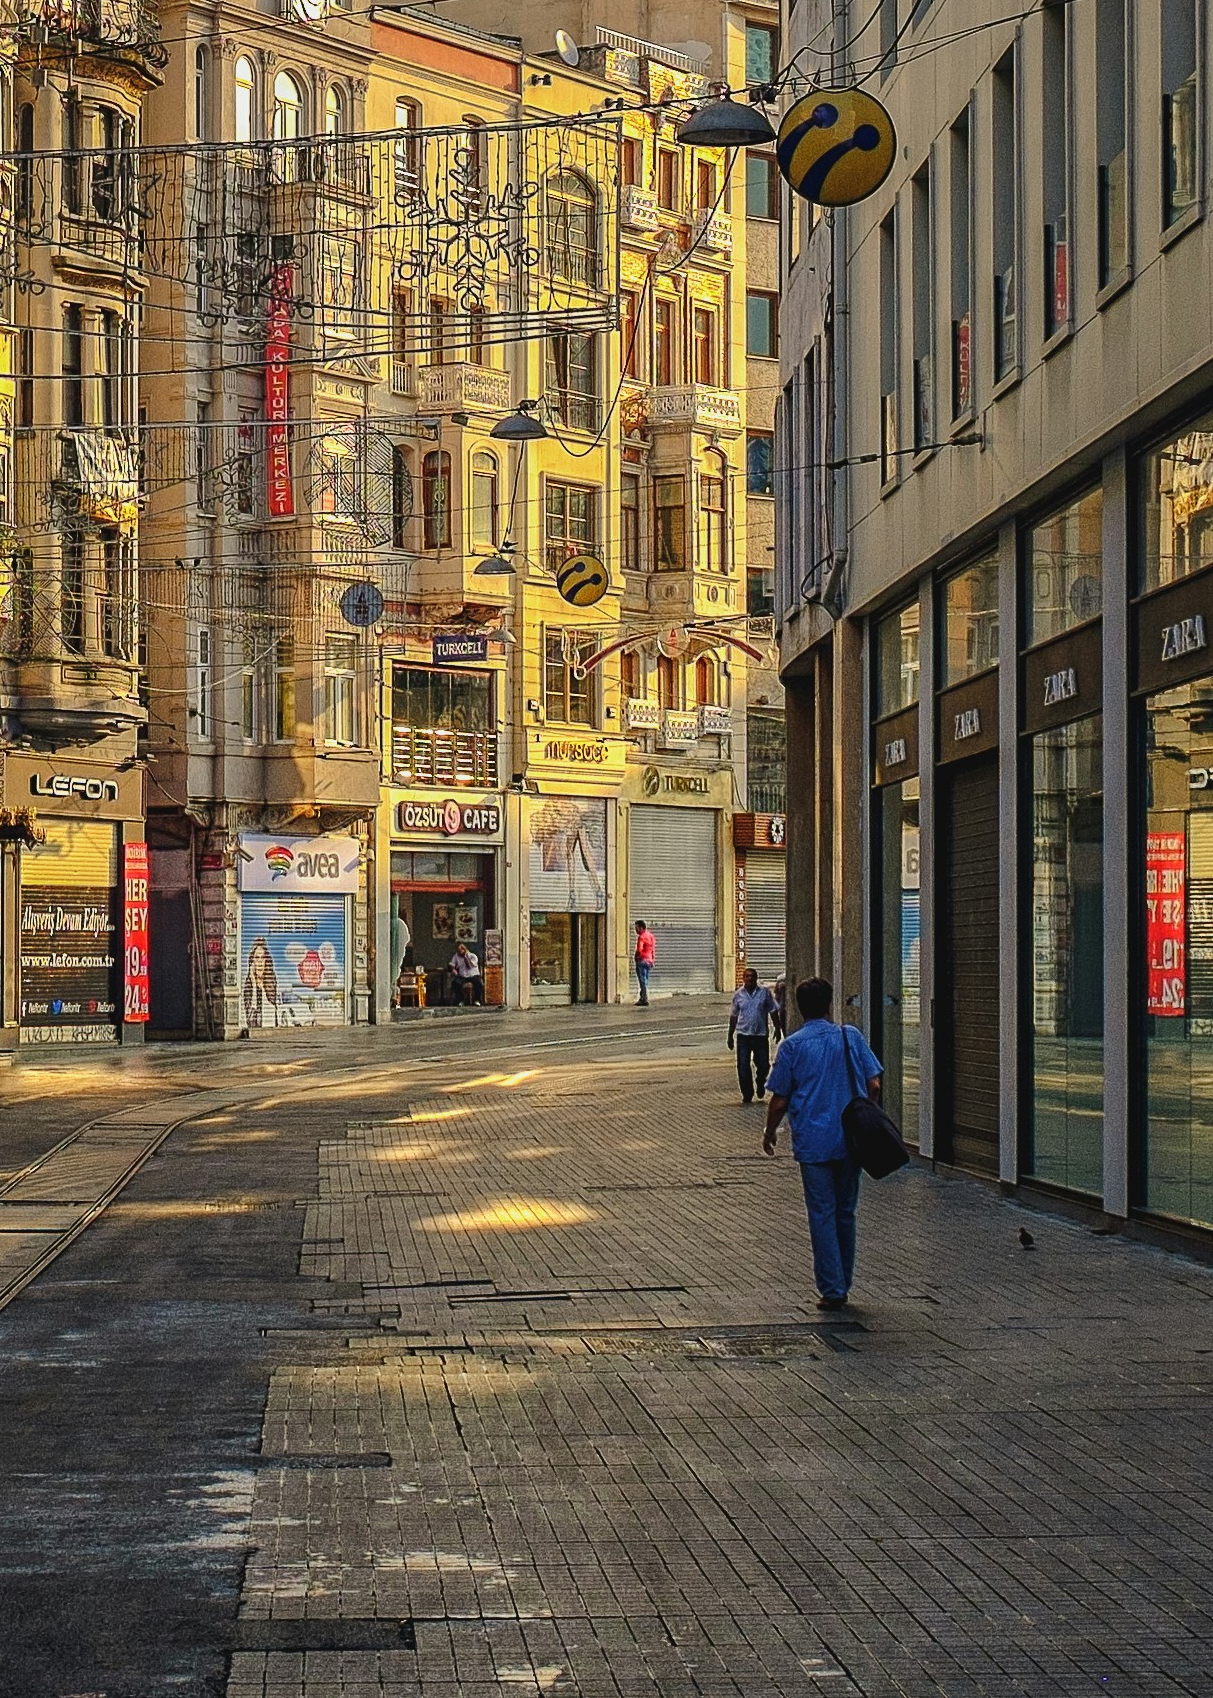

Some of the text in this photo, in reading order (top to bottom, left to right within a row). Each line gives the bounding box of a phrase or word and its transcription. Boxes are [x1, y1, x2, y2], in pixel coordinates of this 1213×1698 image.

[436, 641, 483, 655] TURKCELL
[1162, 615, 1207, 661] ZARA
[1044, 667, 1079, 706] ZARA
[954, 708, 981, 740] ZARA
[885, 738, 906, 767] ZARA
[36, 773, 118, 800] LEFON
[405, 802, 497, 830] ÖZSÜT CAFE
[297, 852, 340, 879] avea
[125, 878, 147, 902] HER
[22, 906, 55, 936] Alışveriş
[56, 907, 82, 931] Devam
[21, 953, 115, 967] www.lefon.com.tr
